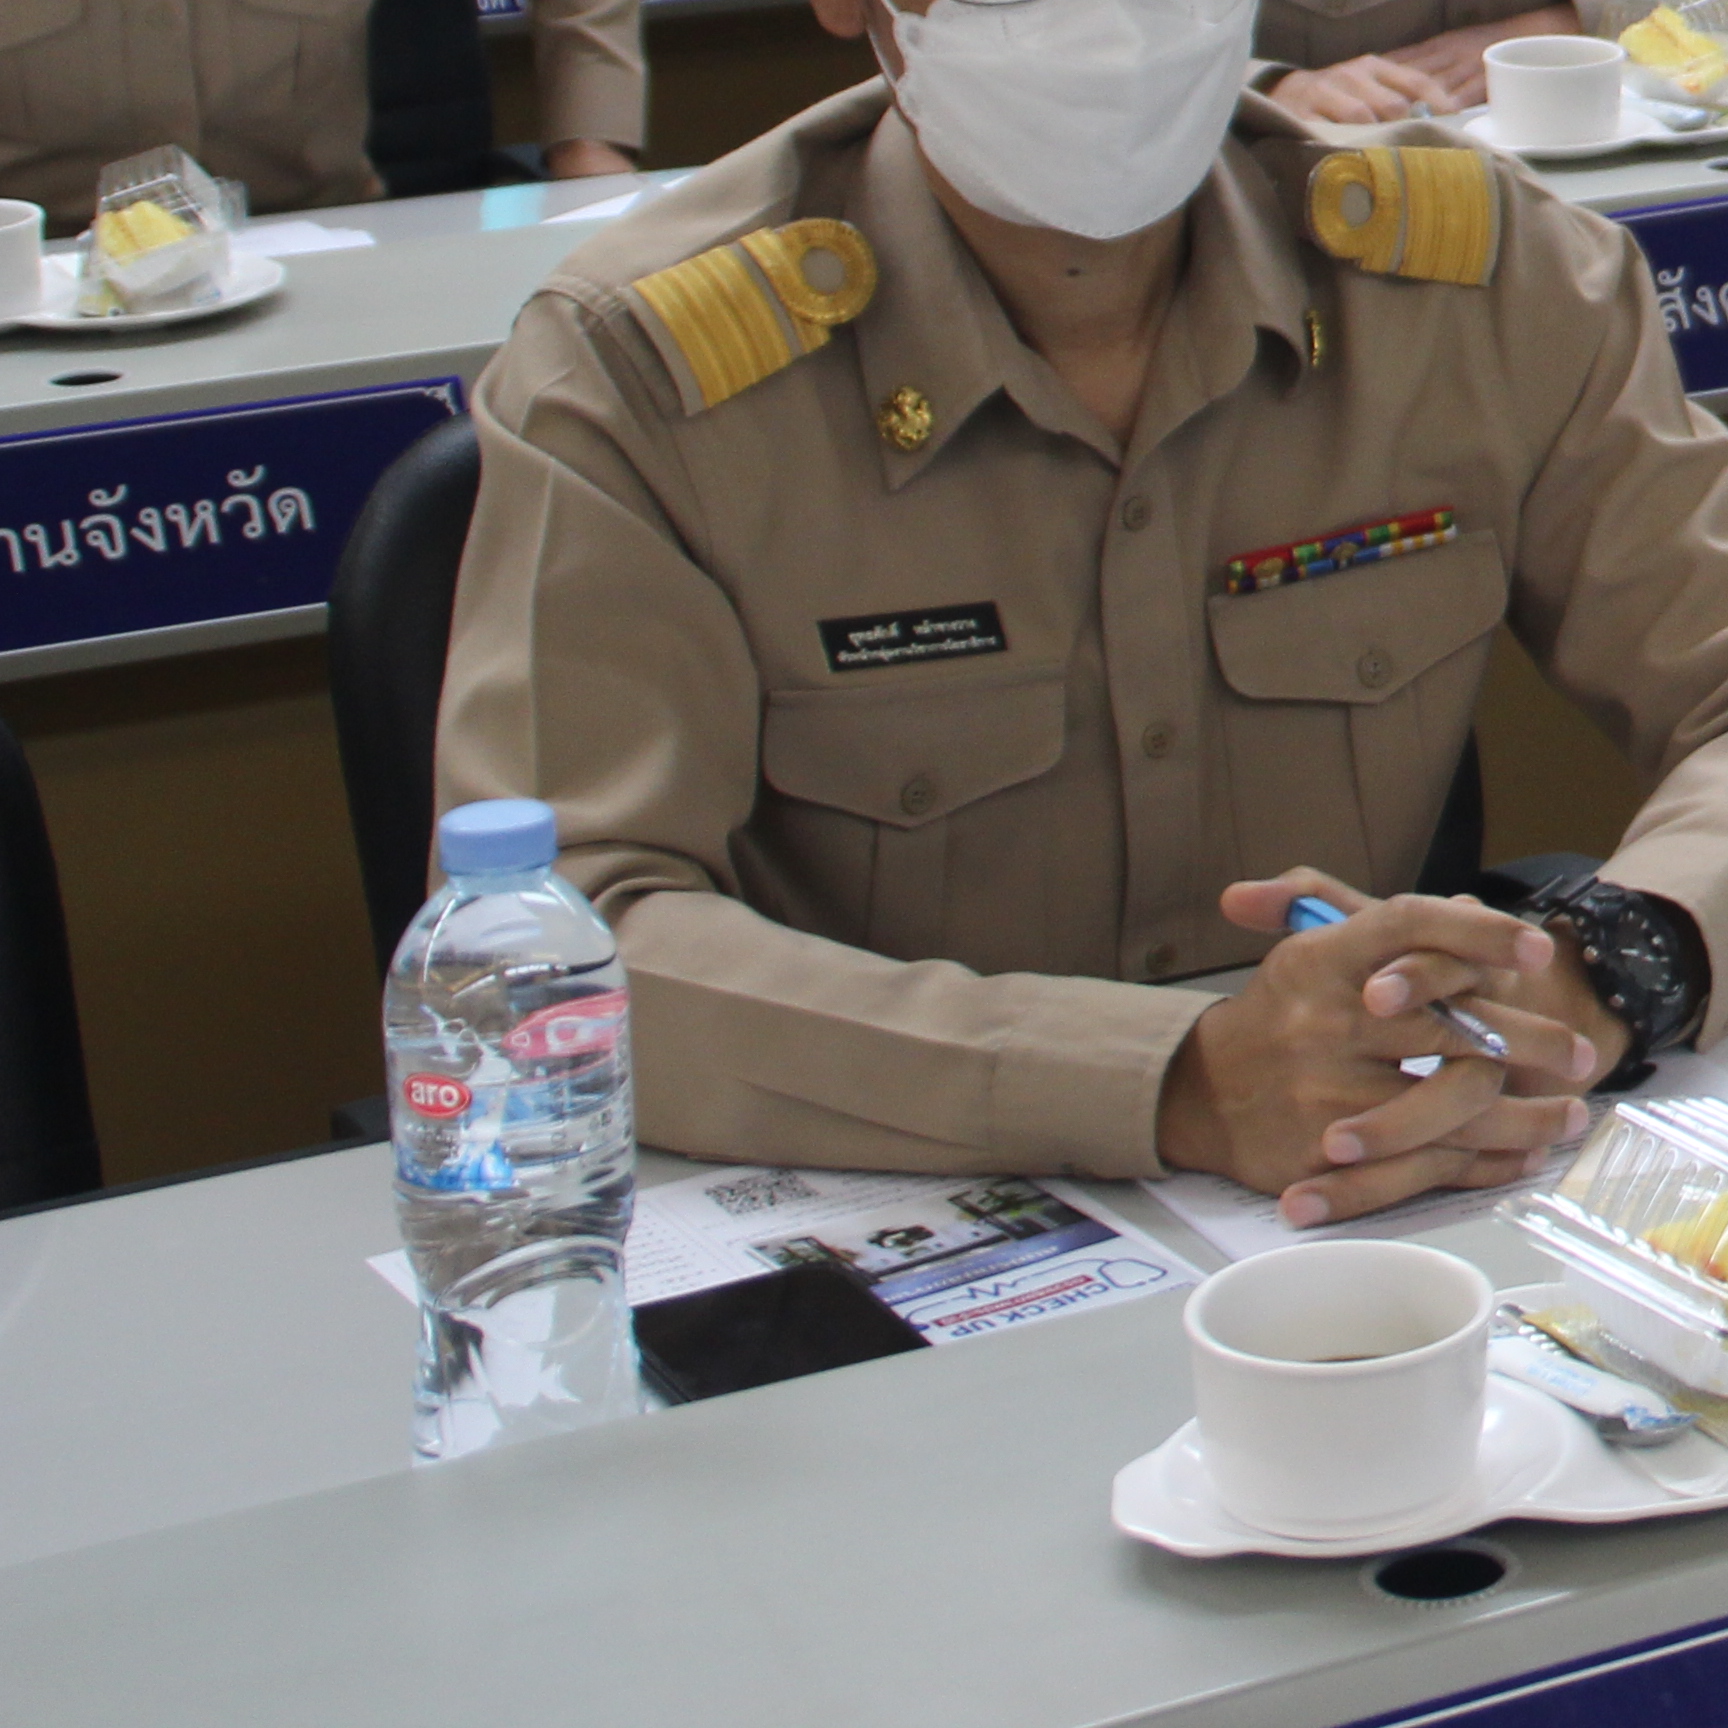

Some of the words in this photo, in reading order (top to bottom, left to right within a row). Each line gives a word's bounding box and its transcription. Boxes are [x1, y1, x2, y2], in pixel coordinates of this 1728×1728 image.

[411, 1081, 461, 1109] aro
[998, 1281, 1109, 1323] CHECK
[950, 1318, 997, 1338] UP
